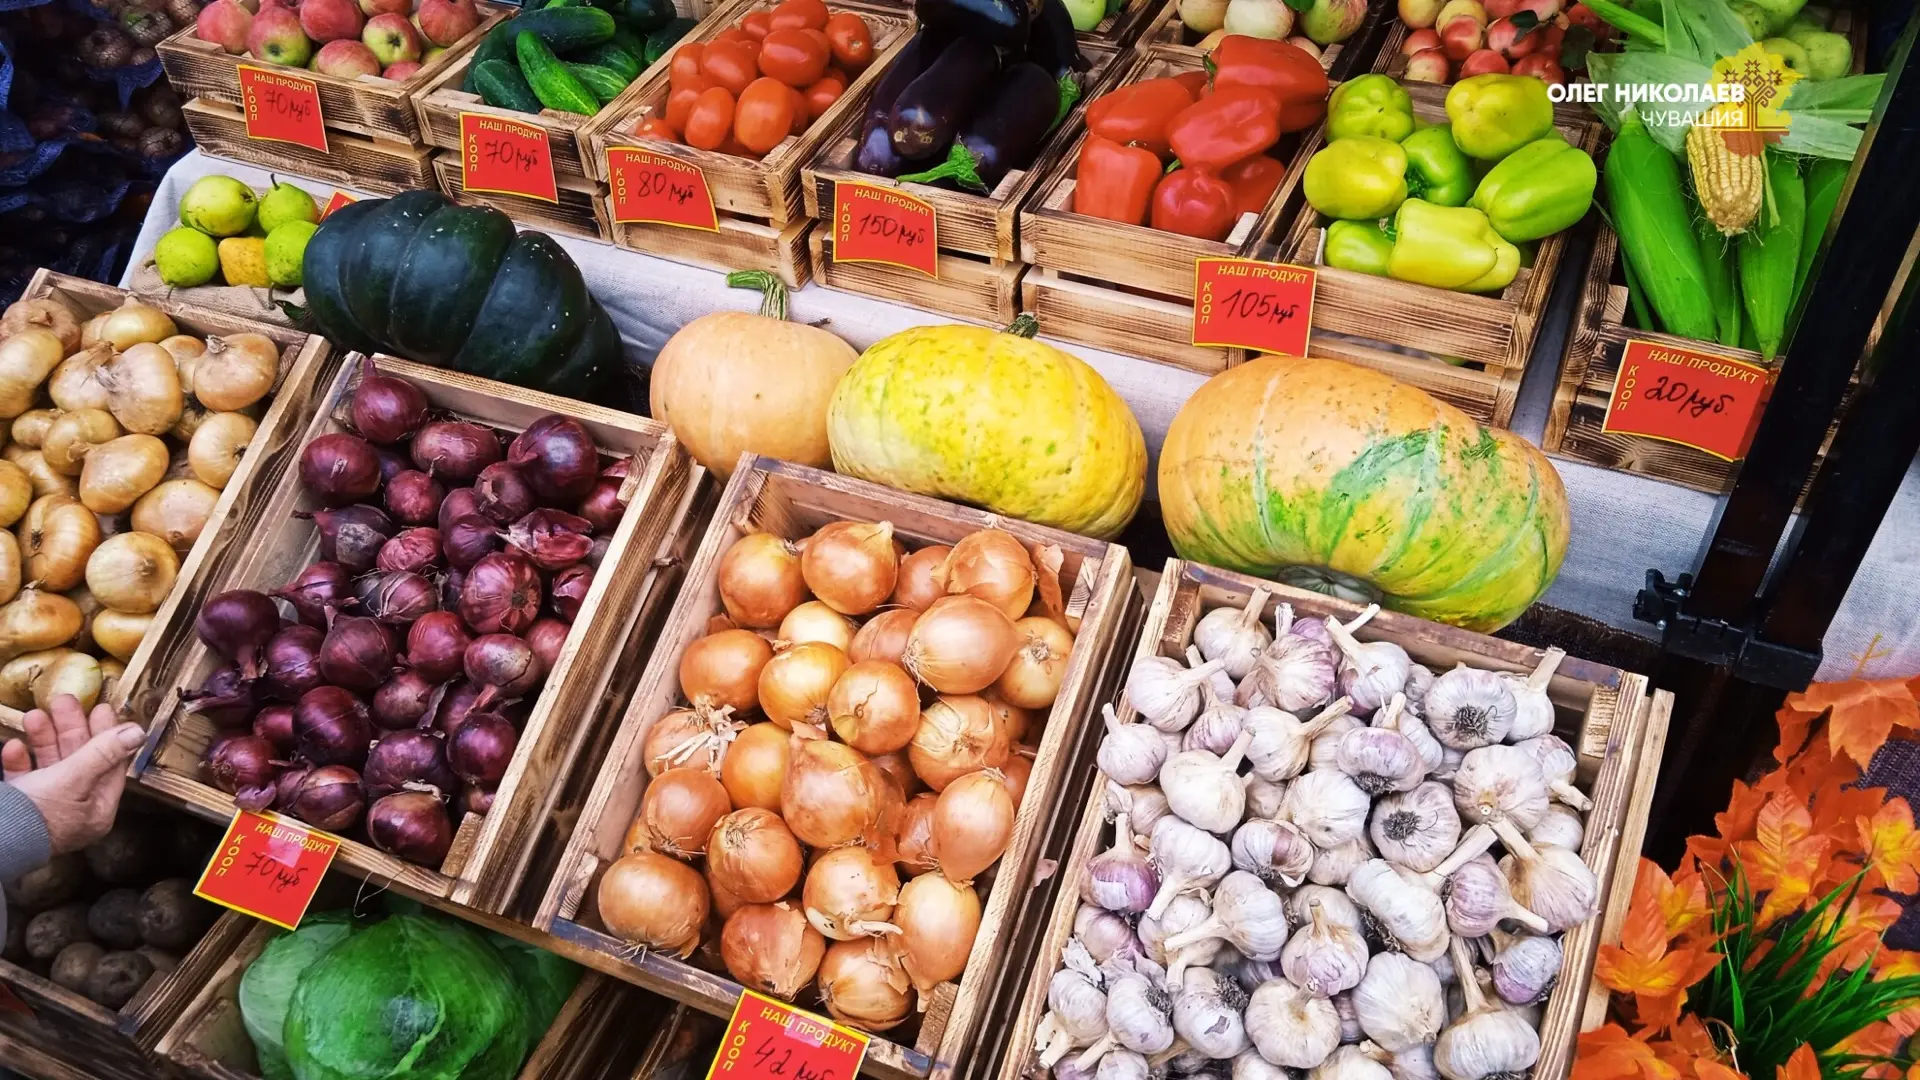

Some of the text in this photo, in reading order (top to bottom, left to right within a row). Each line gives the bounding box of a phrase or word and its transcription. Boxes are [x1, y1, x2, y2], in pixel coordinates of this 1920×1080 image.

[254, 72, 313, 94] НАШ ПРОДУКТ
[479, 120, 542, 141] НАШ ПРОДУКТ
[625, 153, 697, 176] НАШ ПРОДУКТ
[854, 188, 930, 217] НАШ ПРОДУКТ
[1217, 265, 1308, 284] НАШ ПРОДУКТ
[1648, 350, 1760, 385] НАШ ПРОДУКТ
[254, 822, 331, 855] НАШ ПРОДУКТ
[760, 1006, 857, 1054] НАШ ПРОДУКТ
